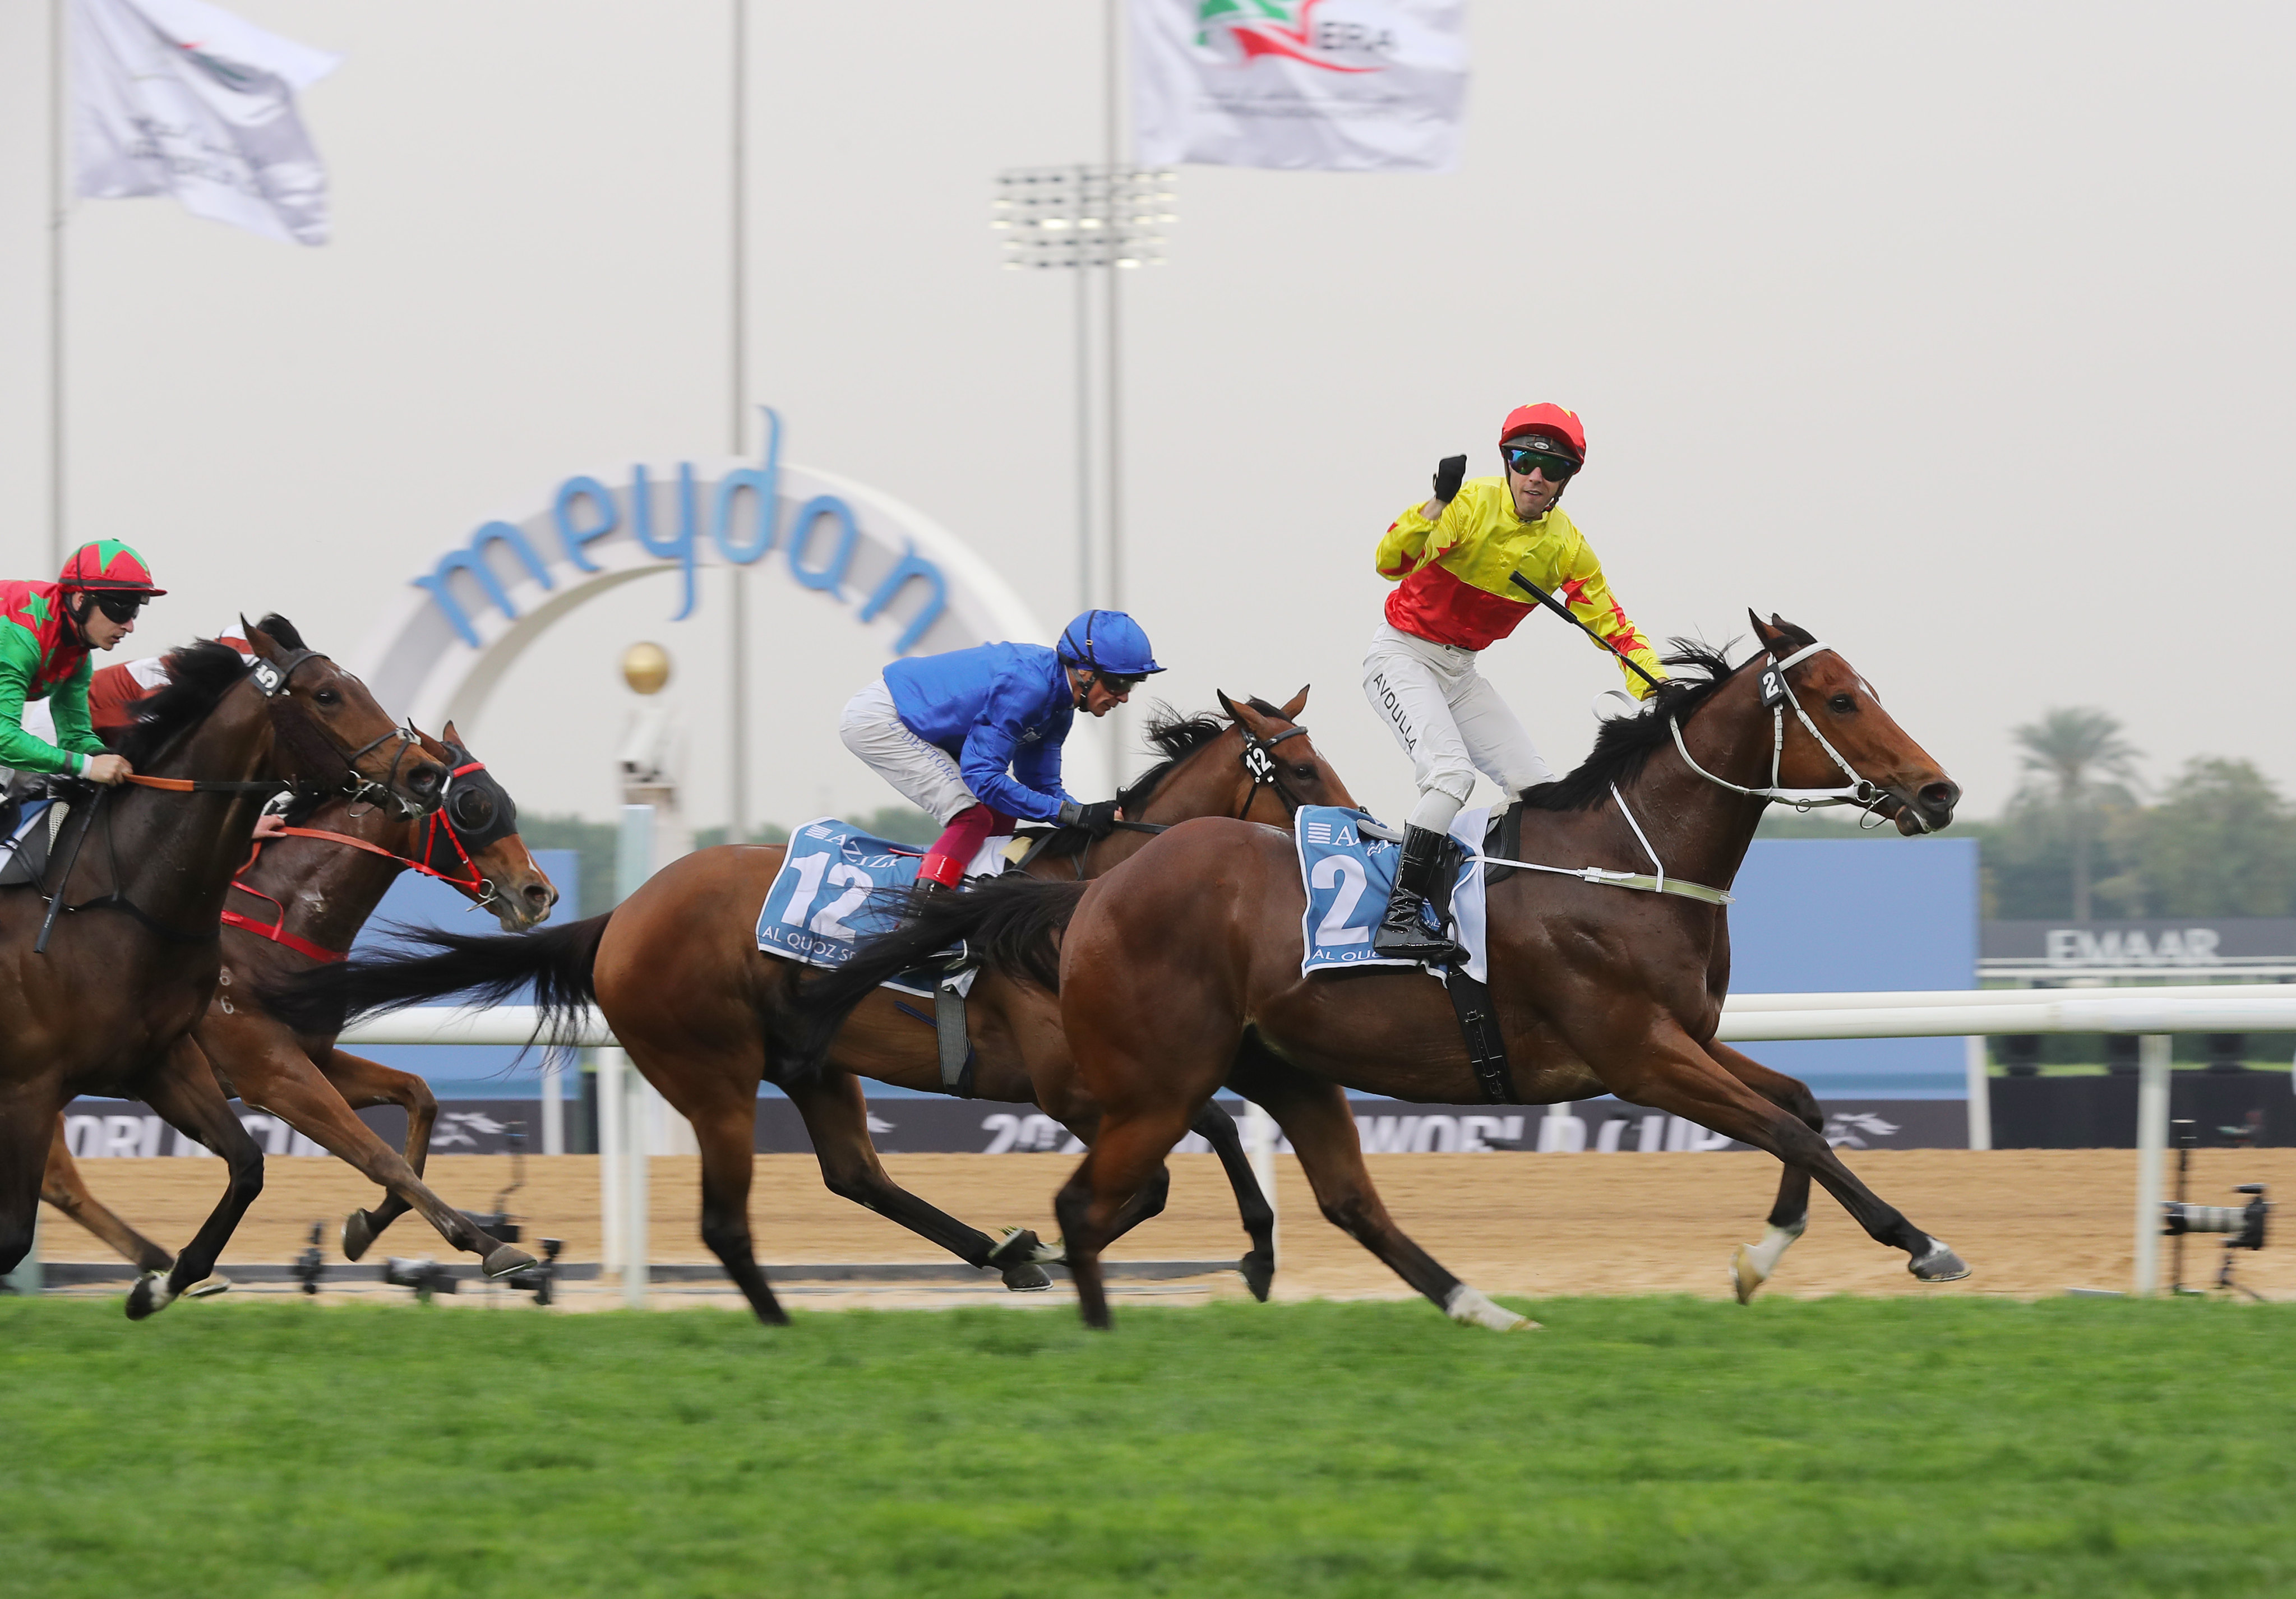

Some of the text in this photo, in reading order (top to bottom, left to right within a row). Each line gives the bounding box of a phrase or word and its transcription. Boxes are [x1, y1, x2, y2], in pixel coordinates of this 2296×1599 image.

[411, 406, 949, 655] meydan
[254, 664, 279, 688] 5
[1762, 671, 1779, 699] 2
[1373, 673, 1417, 755] AVDULLA
[901, 731, 959, 782] DETTORI
[1246, 747, 1272, 776] 12
[780, 851, 874, 945] 12
[1310, 854, 1370, 947] 2
[761, 925, 782, 943] AL
[787, 932, 838, 959] QUOZ
[1311, 949, 1336, 961] AL
[2046, 928, 2221, 967] EMAAR
